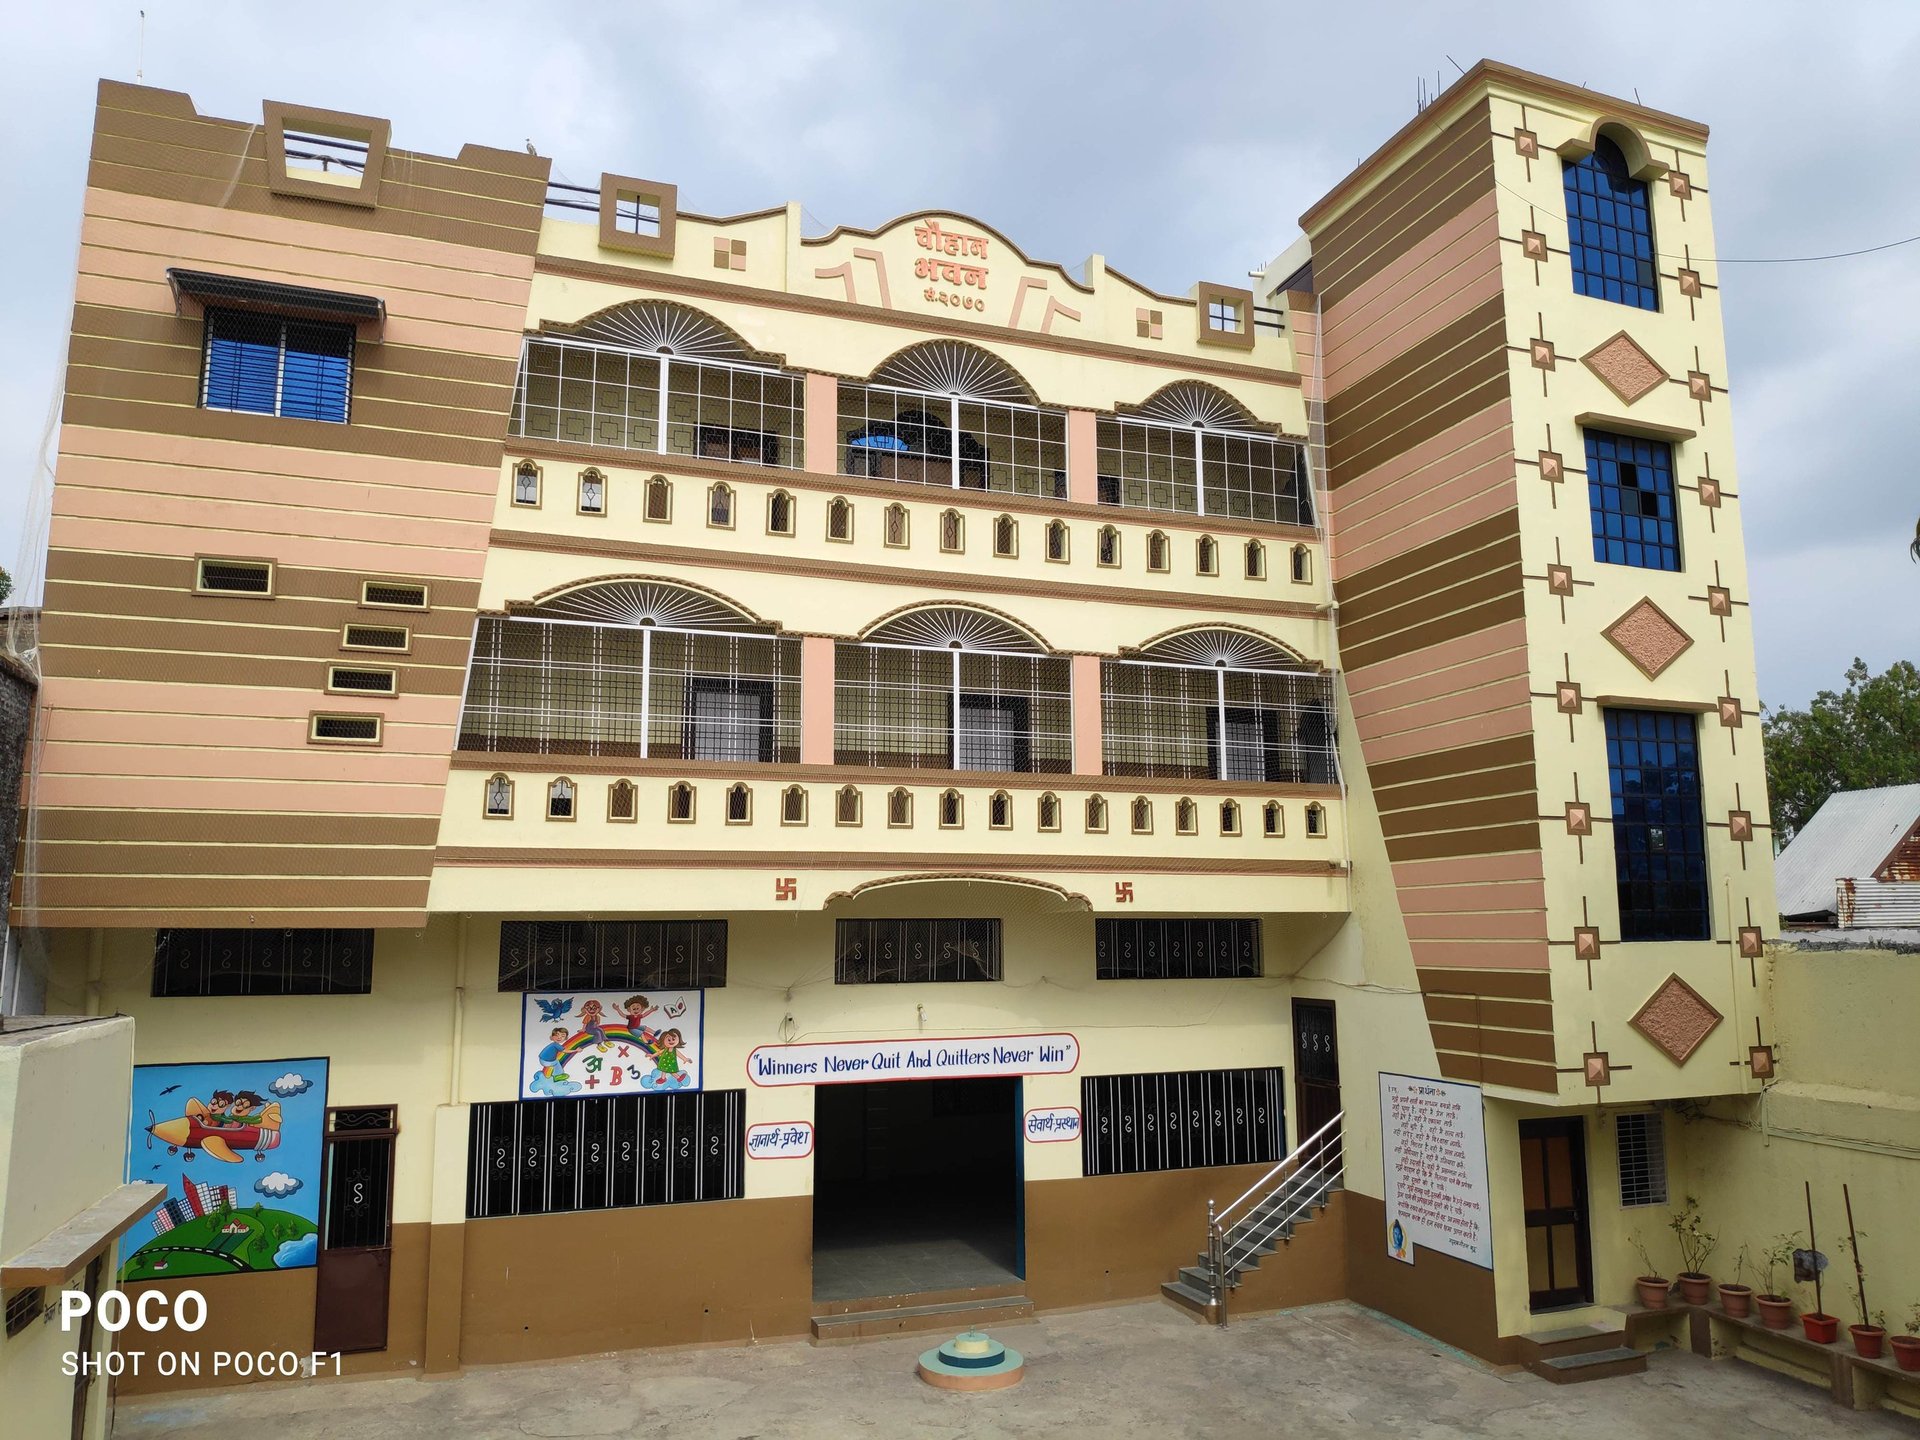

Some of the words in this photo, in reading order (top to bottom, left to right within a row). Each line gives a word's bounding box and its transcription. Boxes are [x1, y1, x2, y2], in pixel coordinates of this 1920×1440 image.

[914, 219, 989, 259] चौहान
[914, 257, 989, 290] भवन
[824, 1054, 869, 1074] Never
[872, 1051, 901, 1071] Quit
[907, 1049, 931, 1068] And
[936, 1046, 990, 1067] Quitters
[993, 1046, 1034, 1064] Never
[609, 1066, 623, 1086] B
